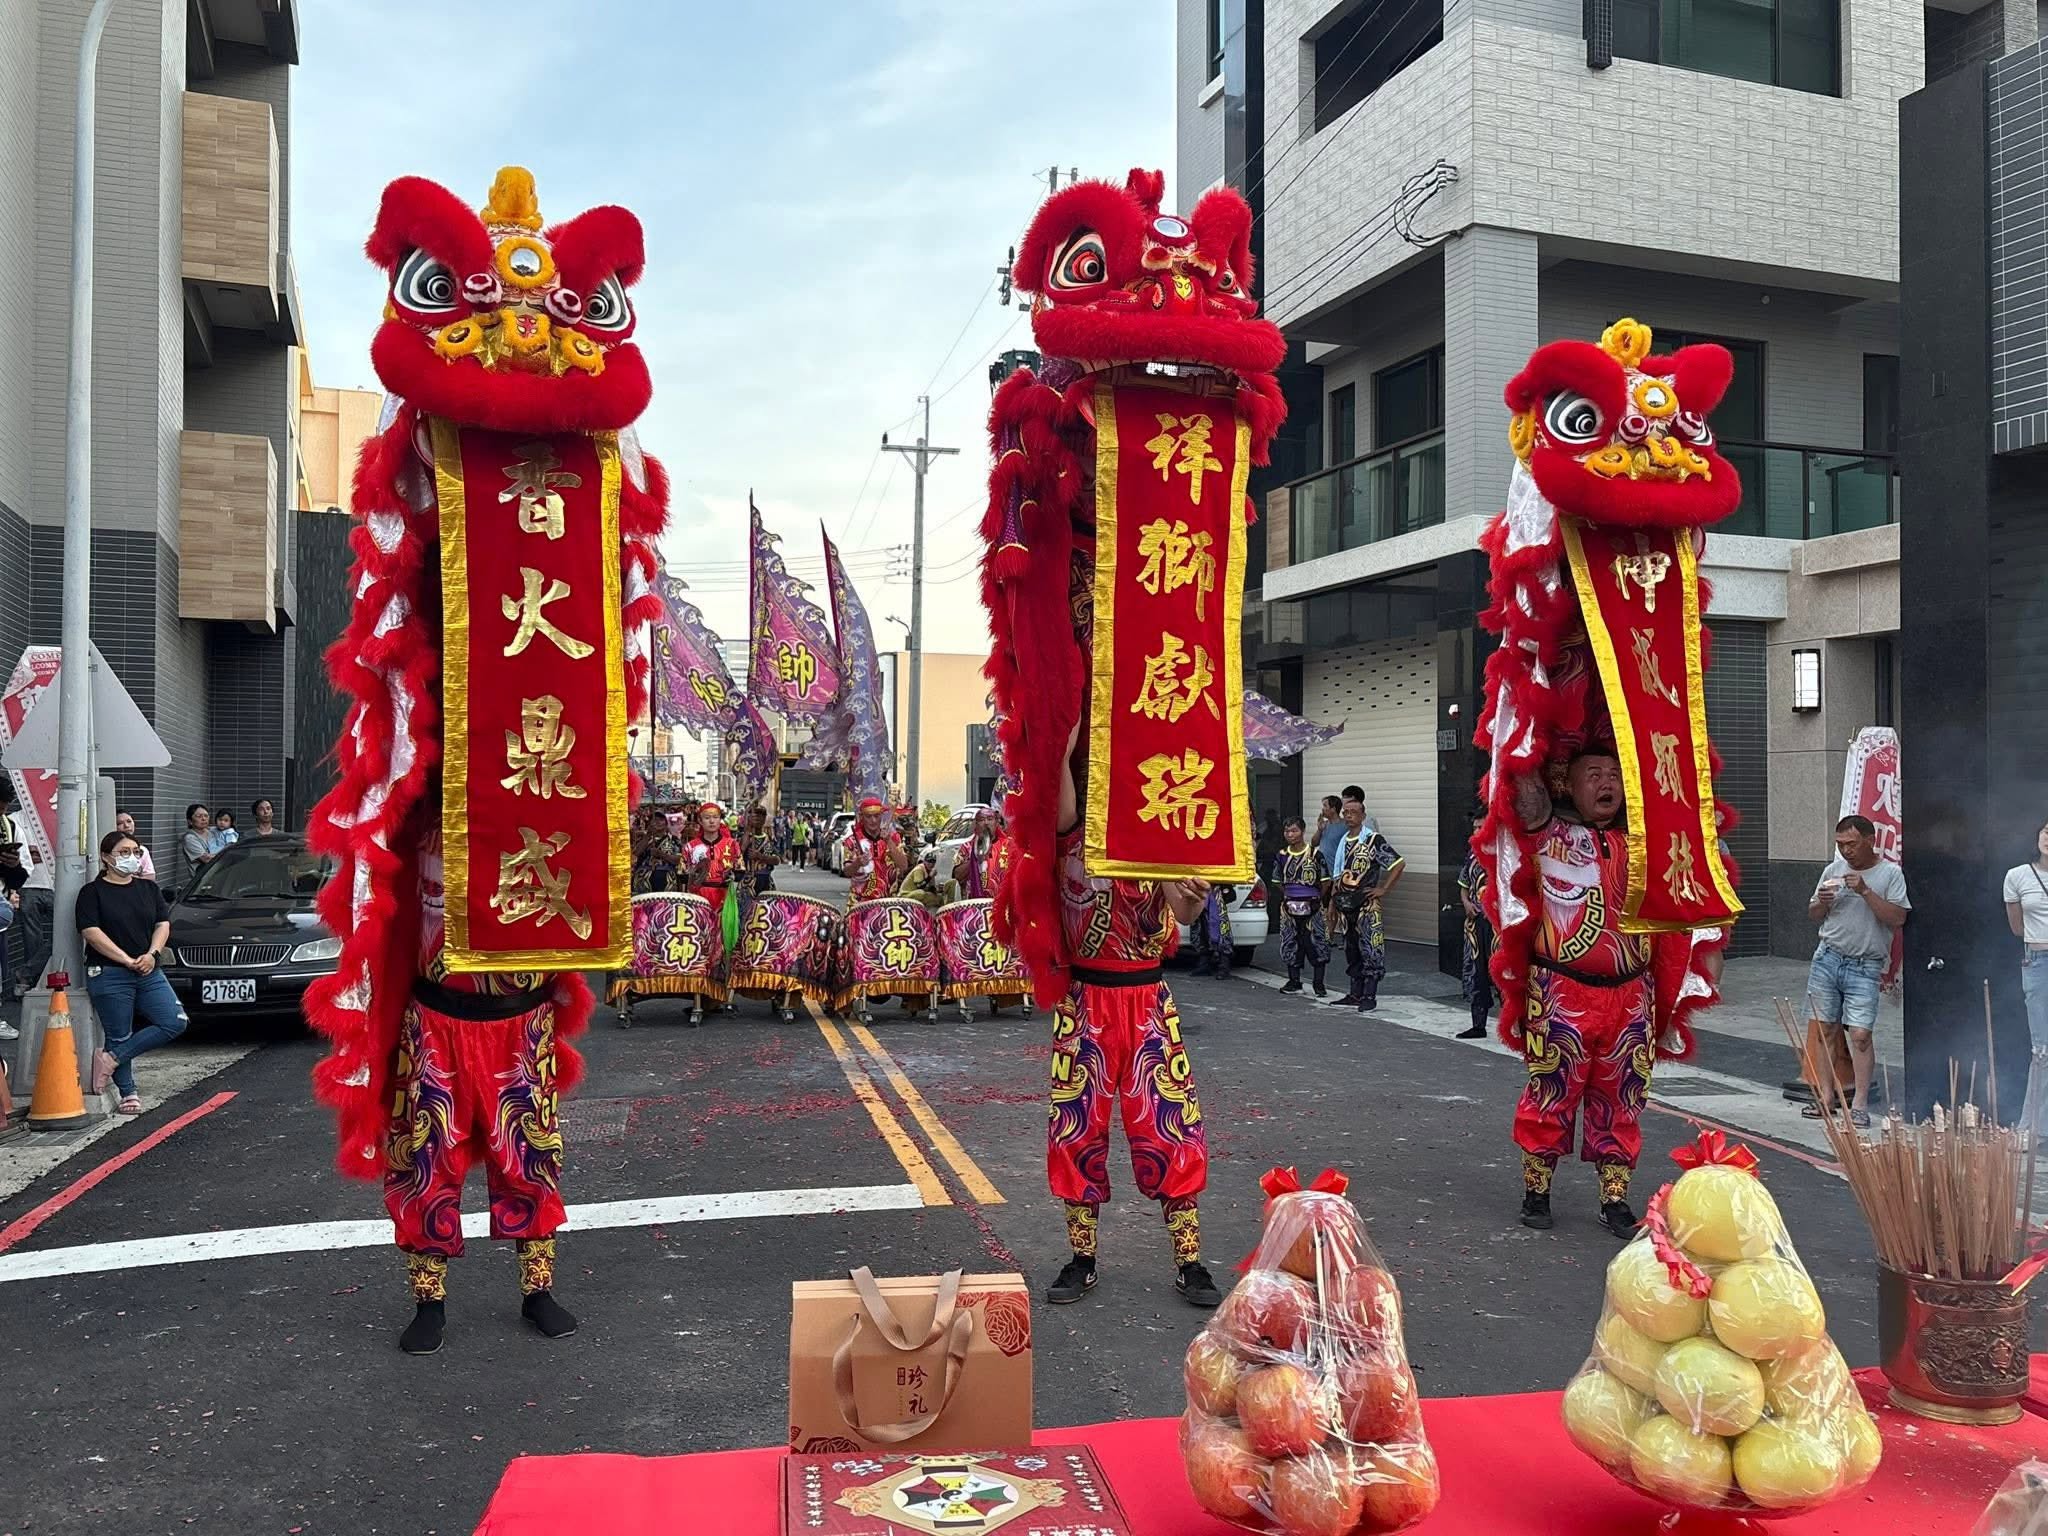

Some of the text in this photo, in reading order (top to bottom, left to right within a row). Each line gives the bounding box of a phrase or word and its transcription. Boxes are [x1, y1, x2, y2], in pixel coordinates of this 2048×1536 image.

[1130, 412, 1223, 841] 祥獅獻瑞
[489, 440, 596, 941] 香火鼎盛
[666, 904, 698, 967] 上帥
[745, 904, 768, 963] 上帥
[883, 909, 914, 971] 上帥
